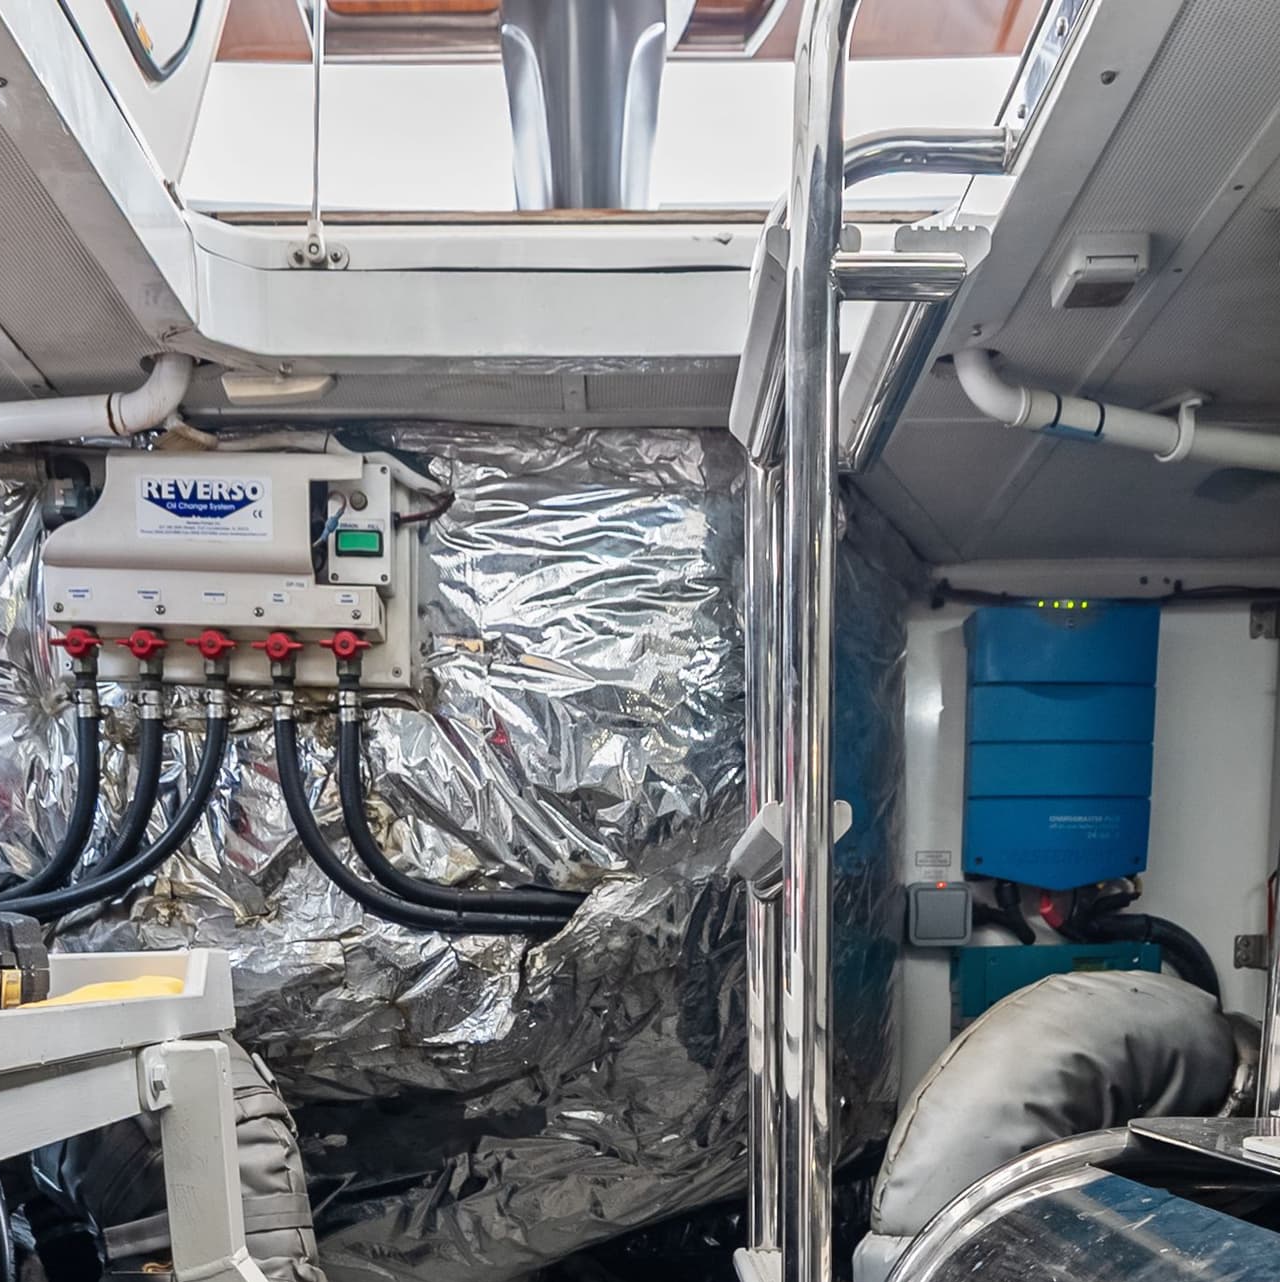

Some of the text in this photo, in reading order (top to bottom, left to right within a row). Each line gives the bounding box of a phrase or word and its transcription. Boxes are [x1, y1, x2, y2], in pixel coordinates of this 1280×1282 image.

[141, 480, 264, 501] REVERSO
[166, 502, 236, 511] Oil Change System
